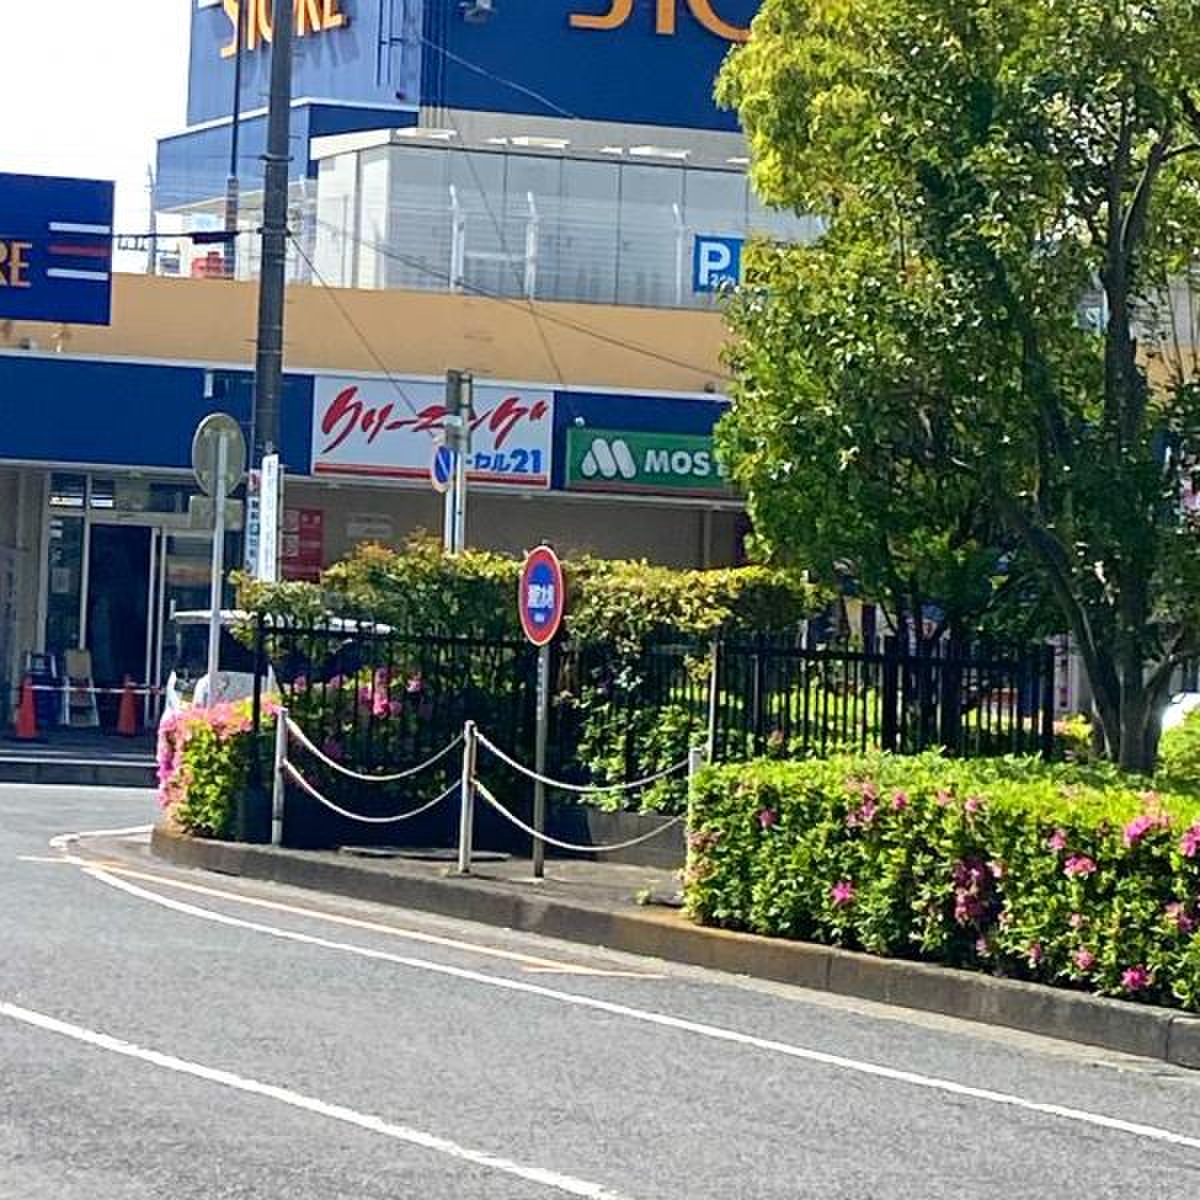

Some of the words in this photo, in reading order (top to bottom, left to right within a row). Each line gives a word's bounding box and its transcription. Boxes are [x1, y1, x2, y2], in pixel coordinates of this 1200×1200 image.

[699, 241, 731, 286] P
[465, 448, 542, 474] ーヤル21
[644, 448, 711, 477] MOS
